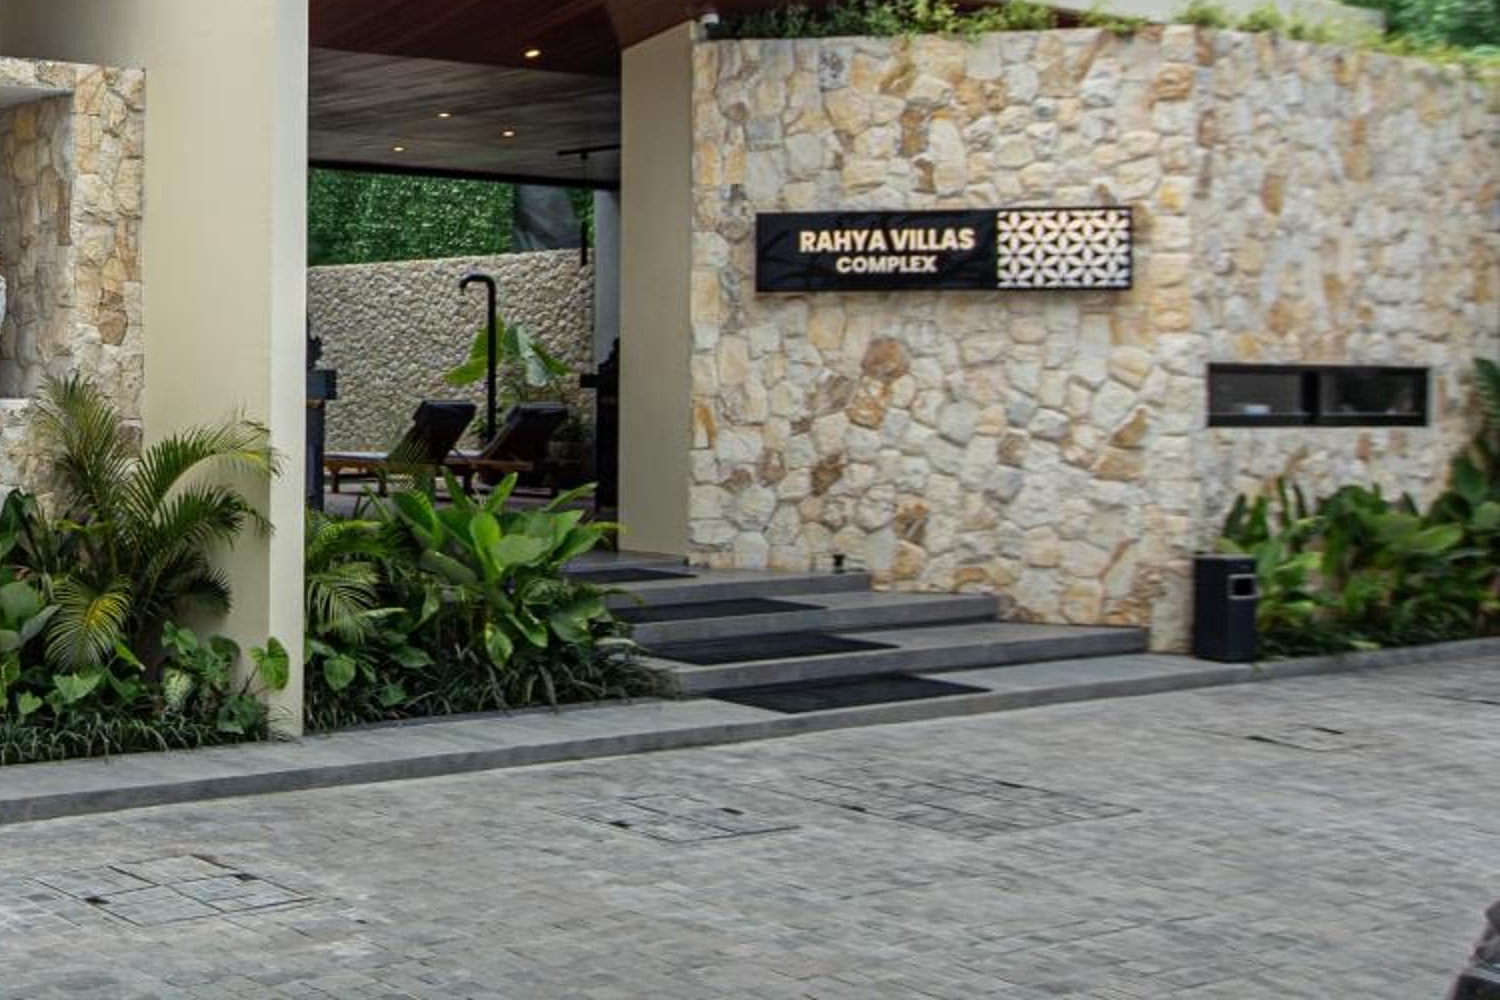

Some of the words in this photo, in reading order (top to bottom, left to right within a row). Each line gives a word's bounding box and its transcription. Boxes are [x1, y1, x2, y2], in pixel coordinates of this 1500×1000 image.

[800, 229, 888, 252] RAHYA
[889, 227, 975, 251] VILLAS
[836, 256, 937, 273] COMPLEX
